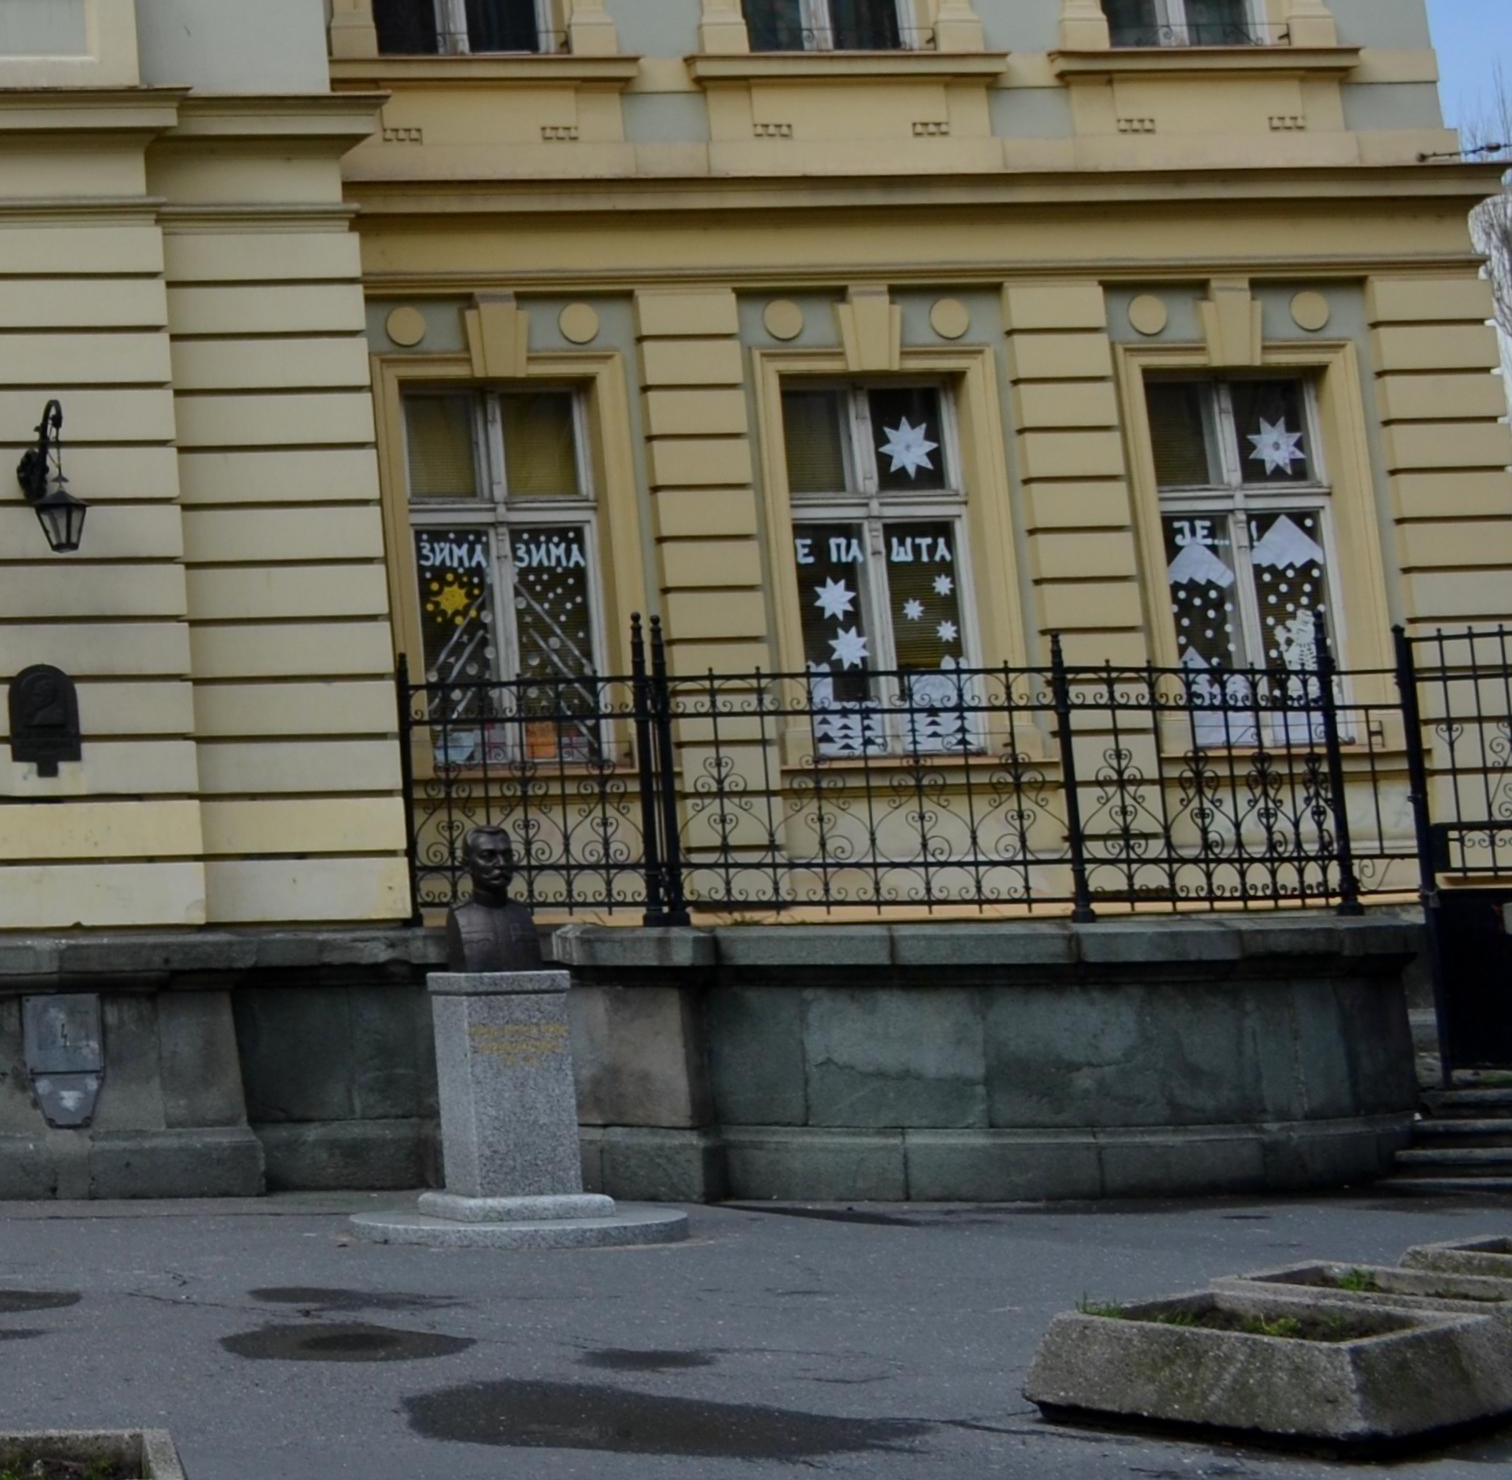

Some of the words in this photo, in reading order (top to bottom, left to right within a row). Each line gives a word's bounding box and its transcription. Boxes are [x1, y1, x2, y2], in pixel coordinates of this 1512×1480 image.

[419, 542, 488, 568] ЗИМА
[514, 543, 586, 568] ЗИМА
[795, 538, 815, 564] Е
[891, 536, 952, 562] ШТА
